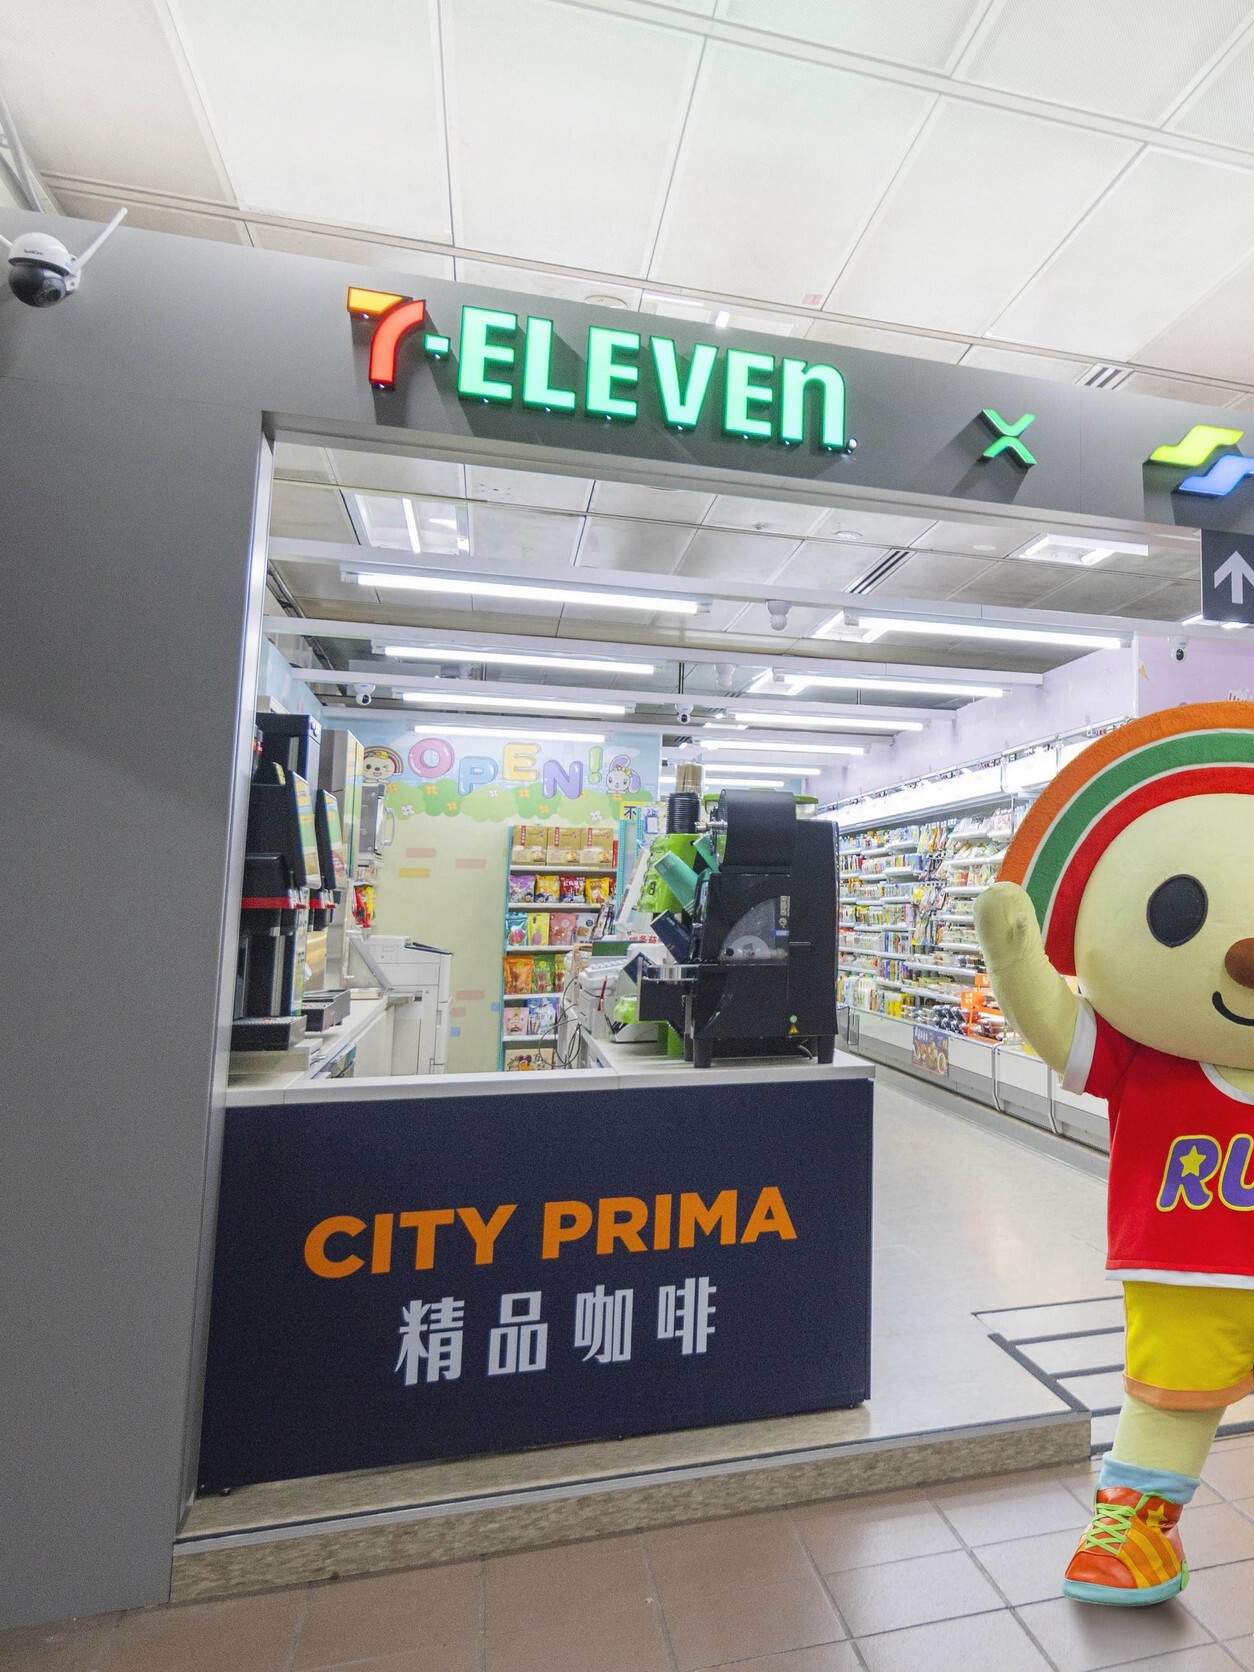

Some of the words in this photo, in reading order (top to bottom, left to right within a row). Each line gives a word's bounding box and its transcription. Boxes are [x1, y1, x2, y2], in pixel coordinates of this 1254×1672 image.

[347, 286, 848, 449] 7-ELEVEn
[304, 1203, 518, 1279] CITY
[541, 1186, 797, 1260] PRIMA
[395, 1276, 717, 1386] 精品咖啡
